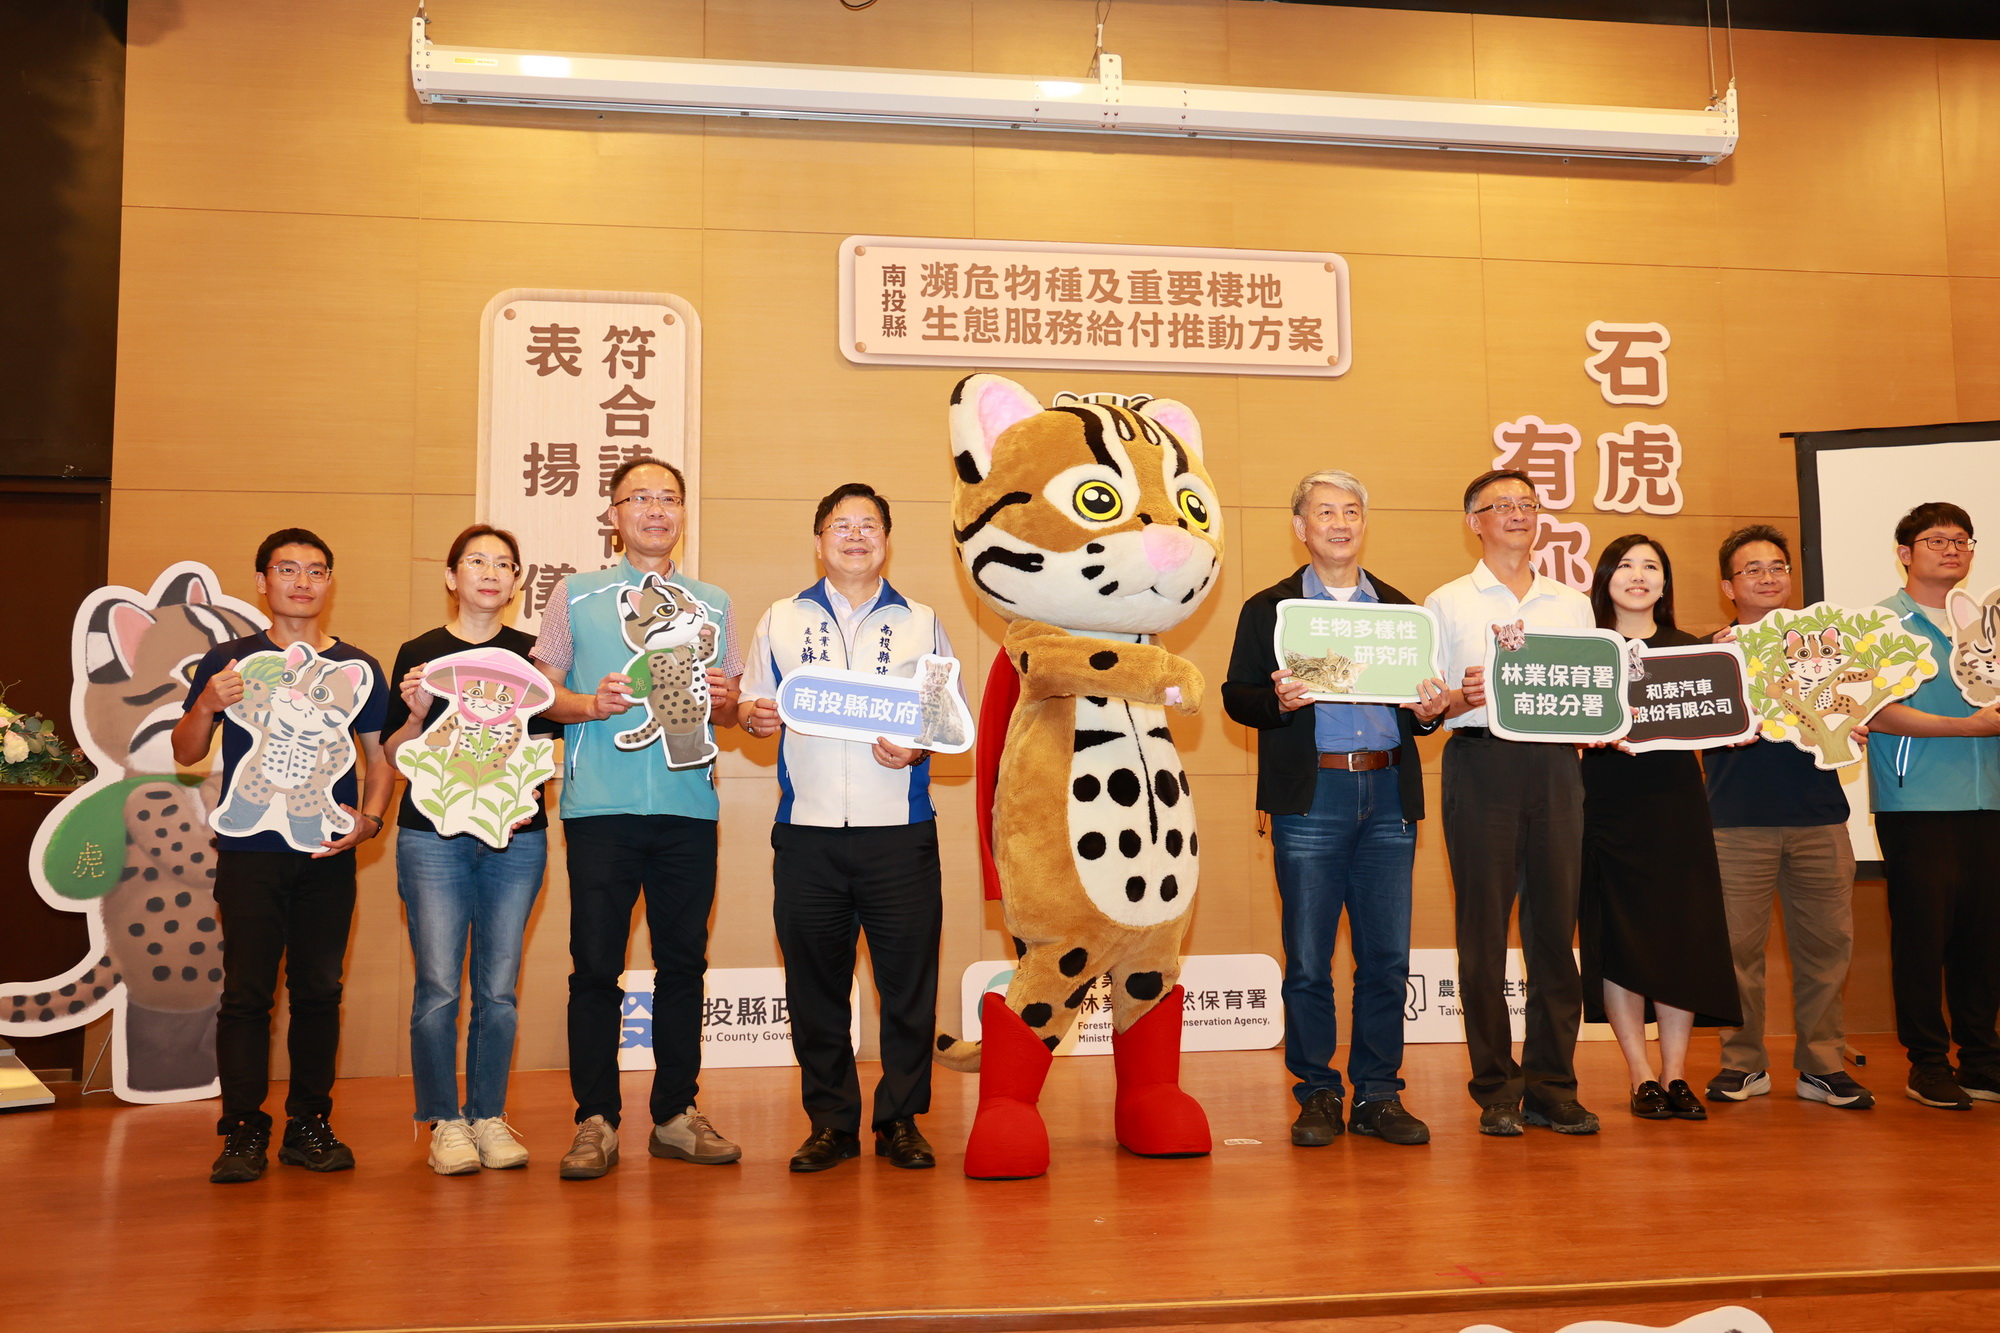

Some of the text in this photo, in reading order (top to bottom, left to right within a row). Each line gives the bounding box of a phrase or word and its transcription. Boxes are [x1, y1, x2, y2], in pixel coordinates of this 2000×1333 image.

[919, 261, 1283, 310] 瀕危物種及重要棲地
[881, 264, 907, 338] 南投縣
[921, 304, 1324, 353] 生態服務給付推動方案
[1593, 328, 1676, 506] 石虎
[1309, 616, 1418, 641] 生物多樣性
[1353, 646, 1418, 667] 研究所
[1500, 663, 1615, 688] 林業保育署
[1646, 679, 1713, 700] 和泰汽車
[793, 686, 920, 725] 南投縣政府
[1513, 692, 1604, 717] 南投分署
[1633, 698, 1733, 724] 股份有限公司
[72, 841, 104, 878] 虎
[716, 1031, 758, 1044] County
